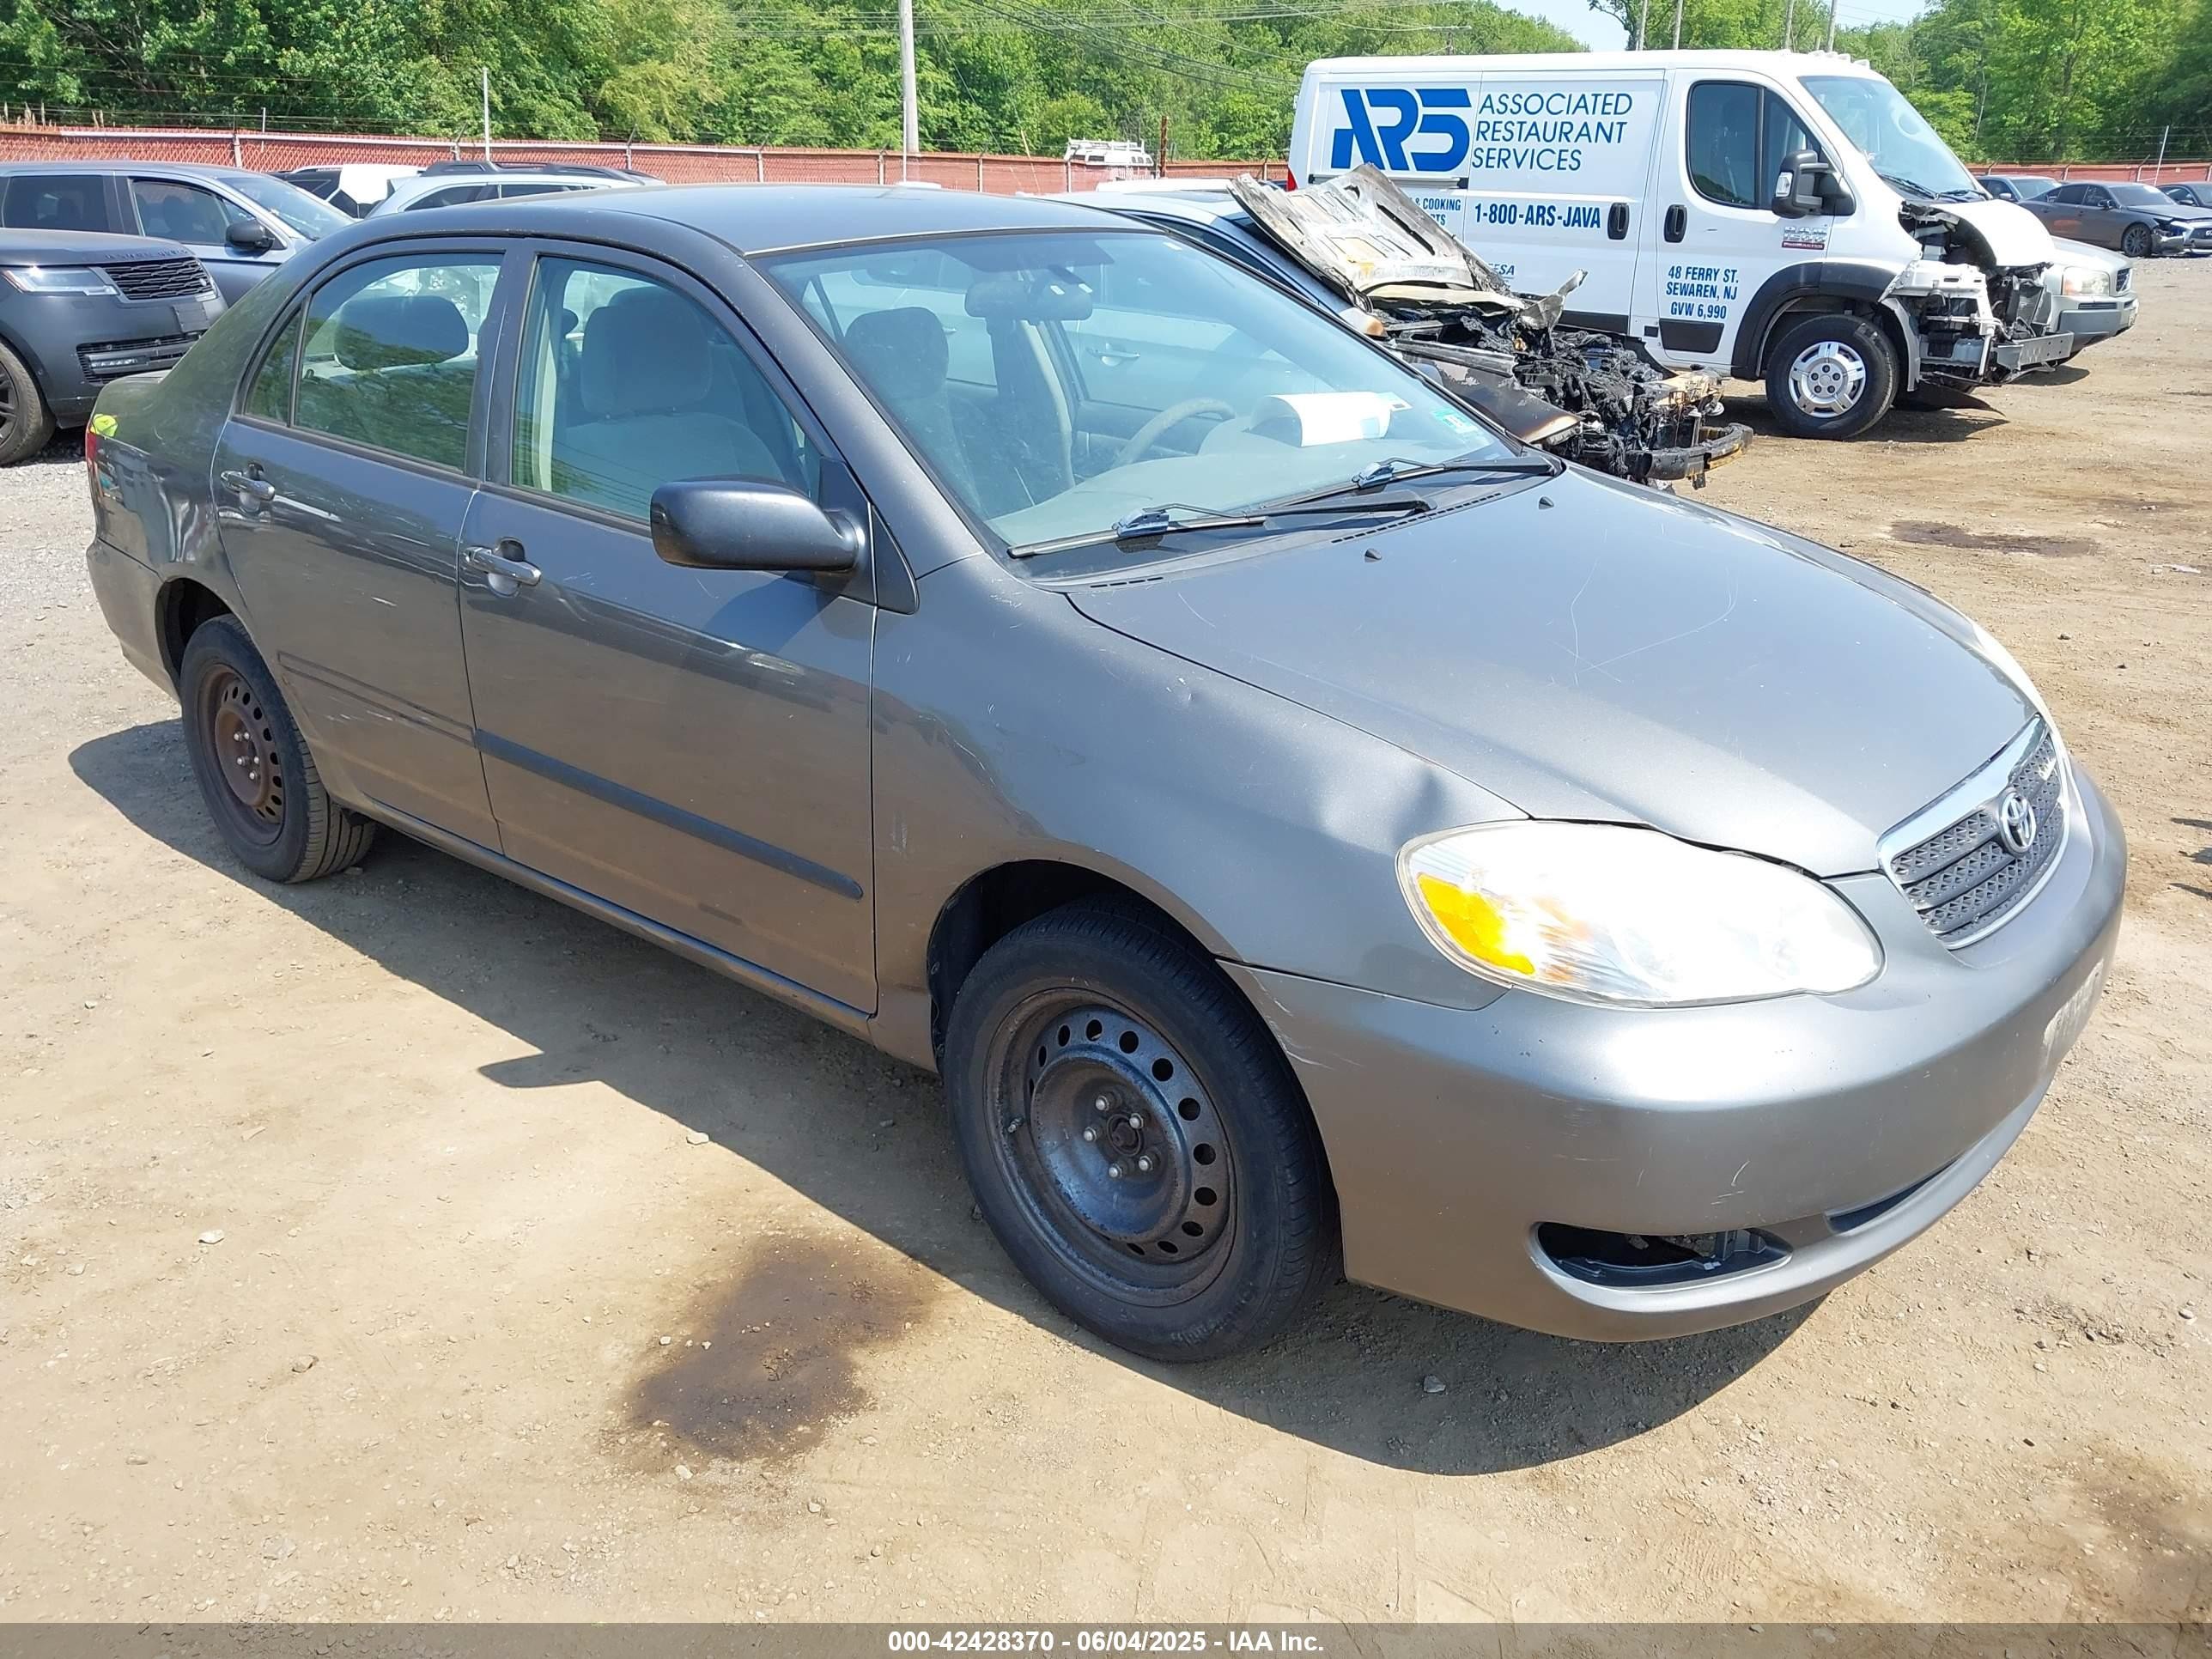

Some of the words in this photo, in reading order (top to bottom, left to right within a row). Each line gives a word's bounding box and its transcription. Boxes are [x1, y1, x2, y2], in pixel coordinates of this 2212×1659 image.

[1478, 93, 1633, 116] ASSOCIATED
[1330, 88, 1472, 172] ARS
[1475, 120, 1628, 143] RESTAURANT
[1472, 148, 1583, 171] SERVICES
[1422, 198, 1462, 211] COOKING
[1474, 203, 1601, 228] 1-800-ARS-JAVA
[1668, 265, 1681, 279] 48
[1685, 266, 1720, 282] FERRY
[1723, 269, 1739, 283] ST.
[1666, 282, 1720, 301] SEWAREN,
[1723, 286, 1738, 301] NJ
[1670, 301, 1694, 317] GVW
[1697, 304, 1727, 320] 6,990
